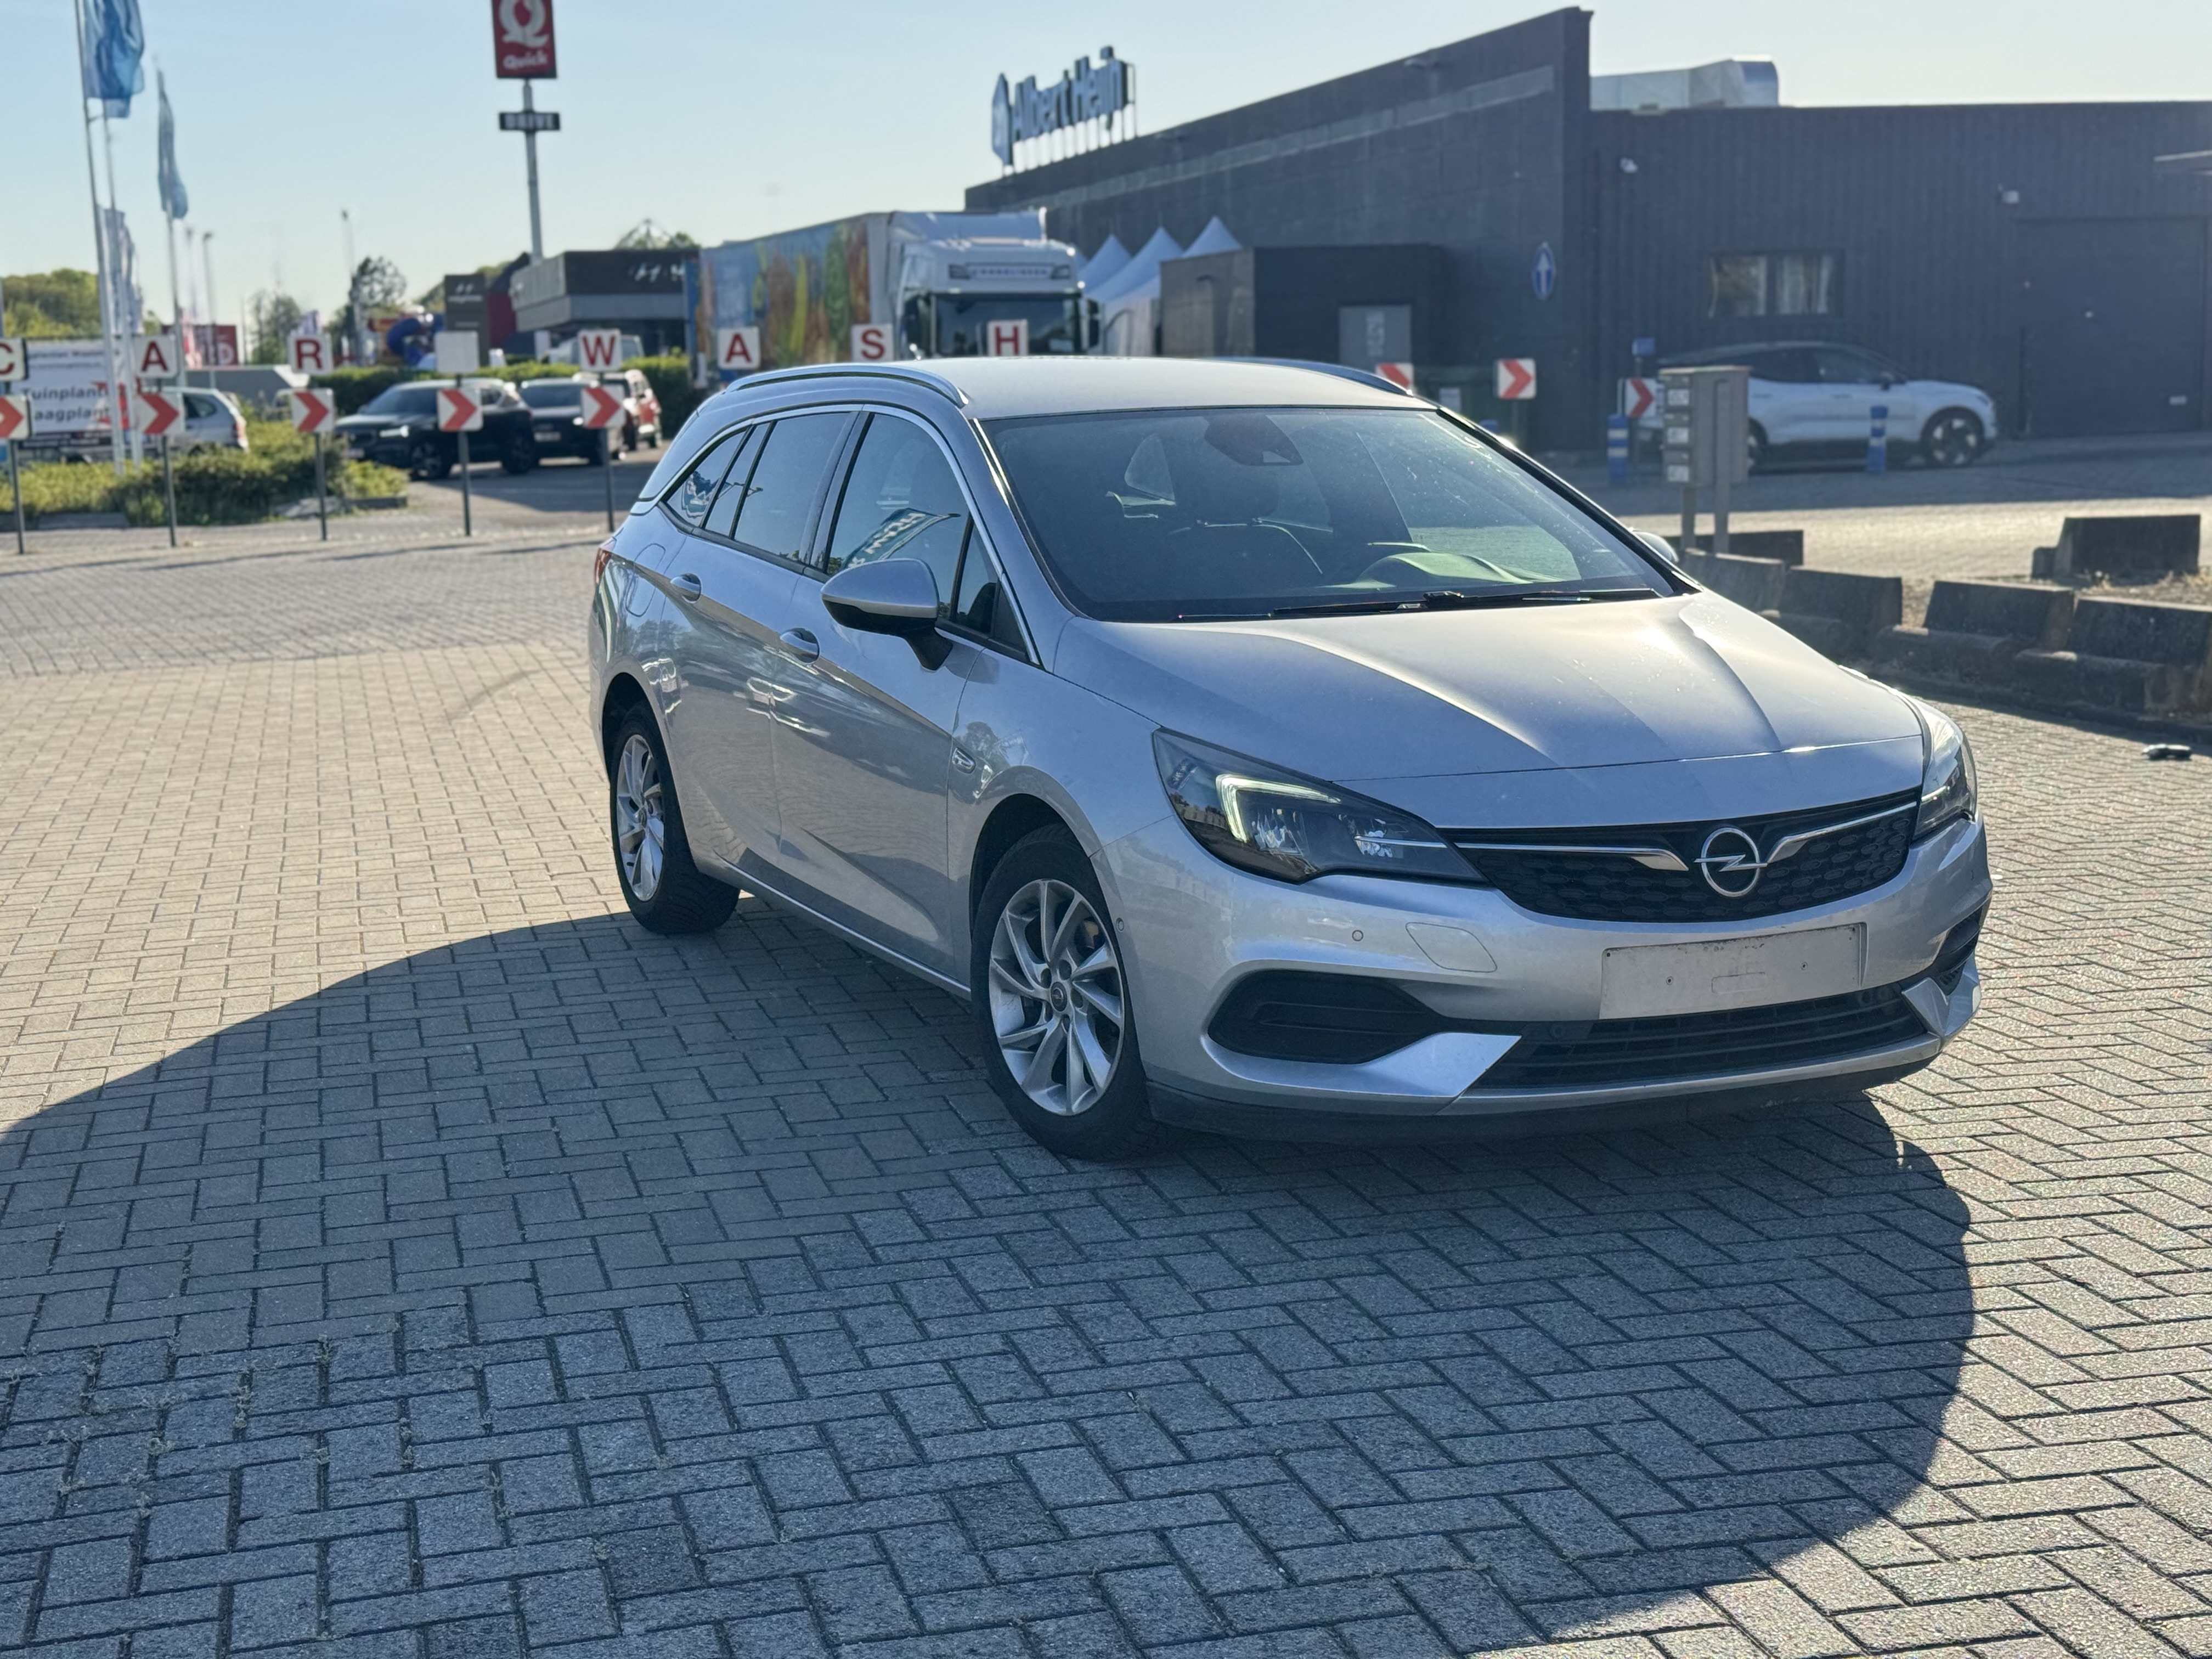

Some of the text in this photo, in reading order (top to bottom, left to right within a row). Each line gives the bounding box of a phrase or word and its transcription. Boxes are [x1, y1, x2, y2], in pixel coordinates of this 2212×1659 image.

[503, 50, 548, 69] Quick
[1011, 69, 1071, 142] Albert
[504, 114, 554, 129] DRIVE
[141, 341, 169, 373] A
[296, 339, 322, 369] R
[582, 336, 616, 366] W
[725, 332, 752, 363] A
[861, 329, 885, 360] S
[995, 326, 1019, 357] H
[34, 406, 110, 422] aagplant
